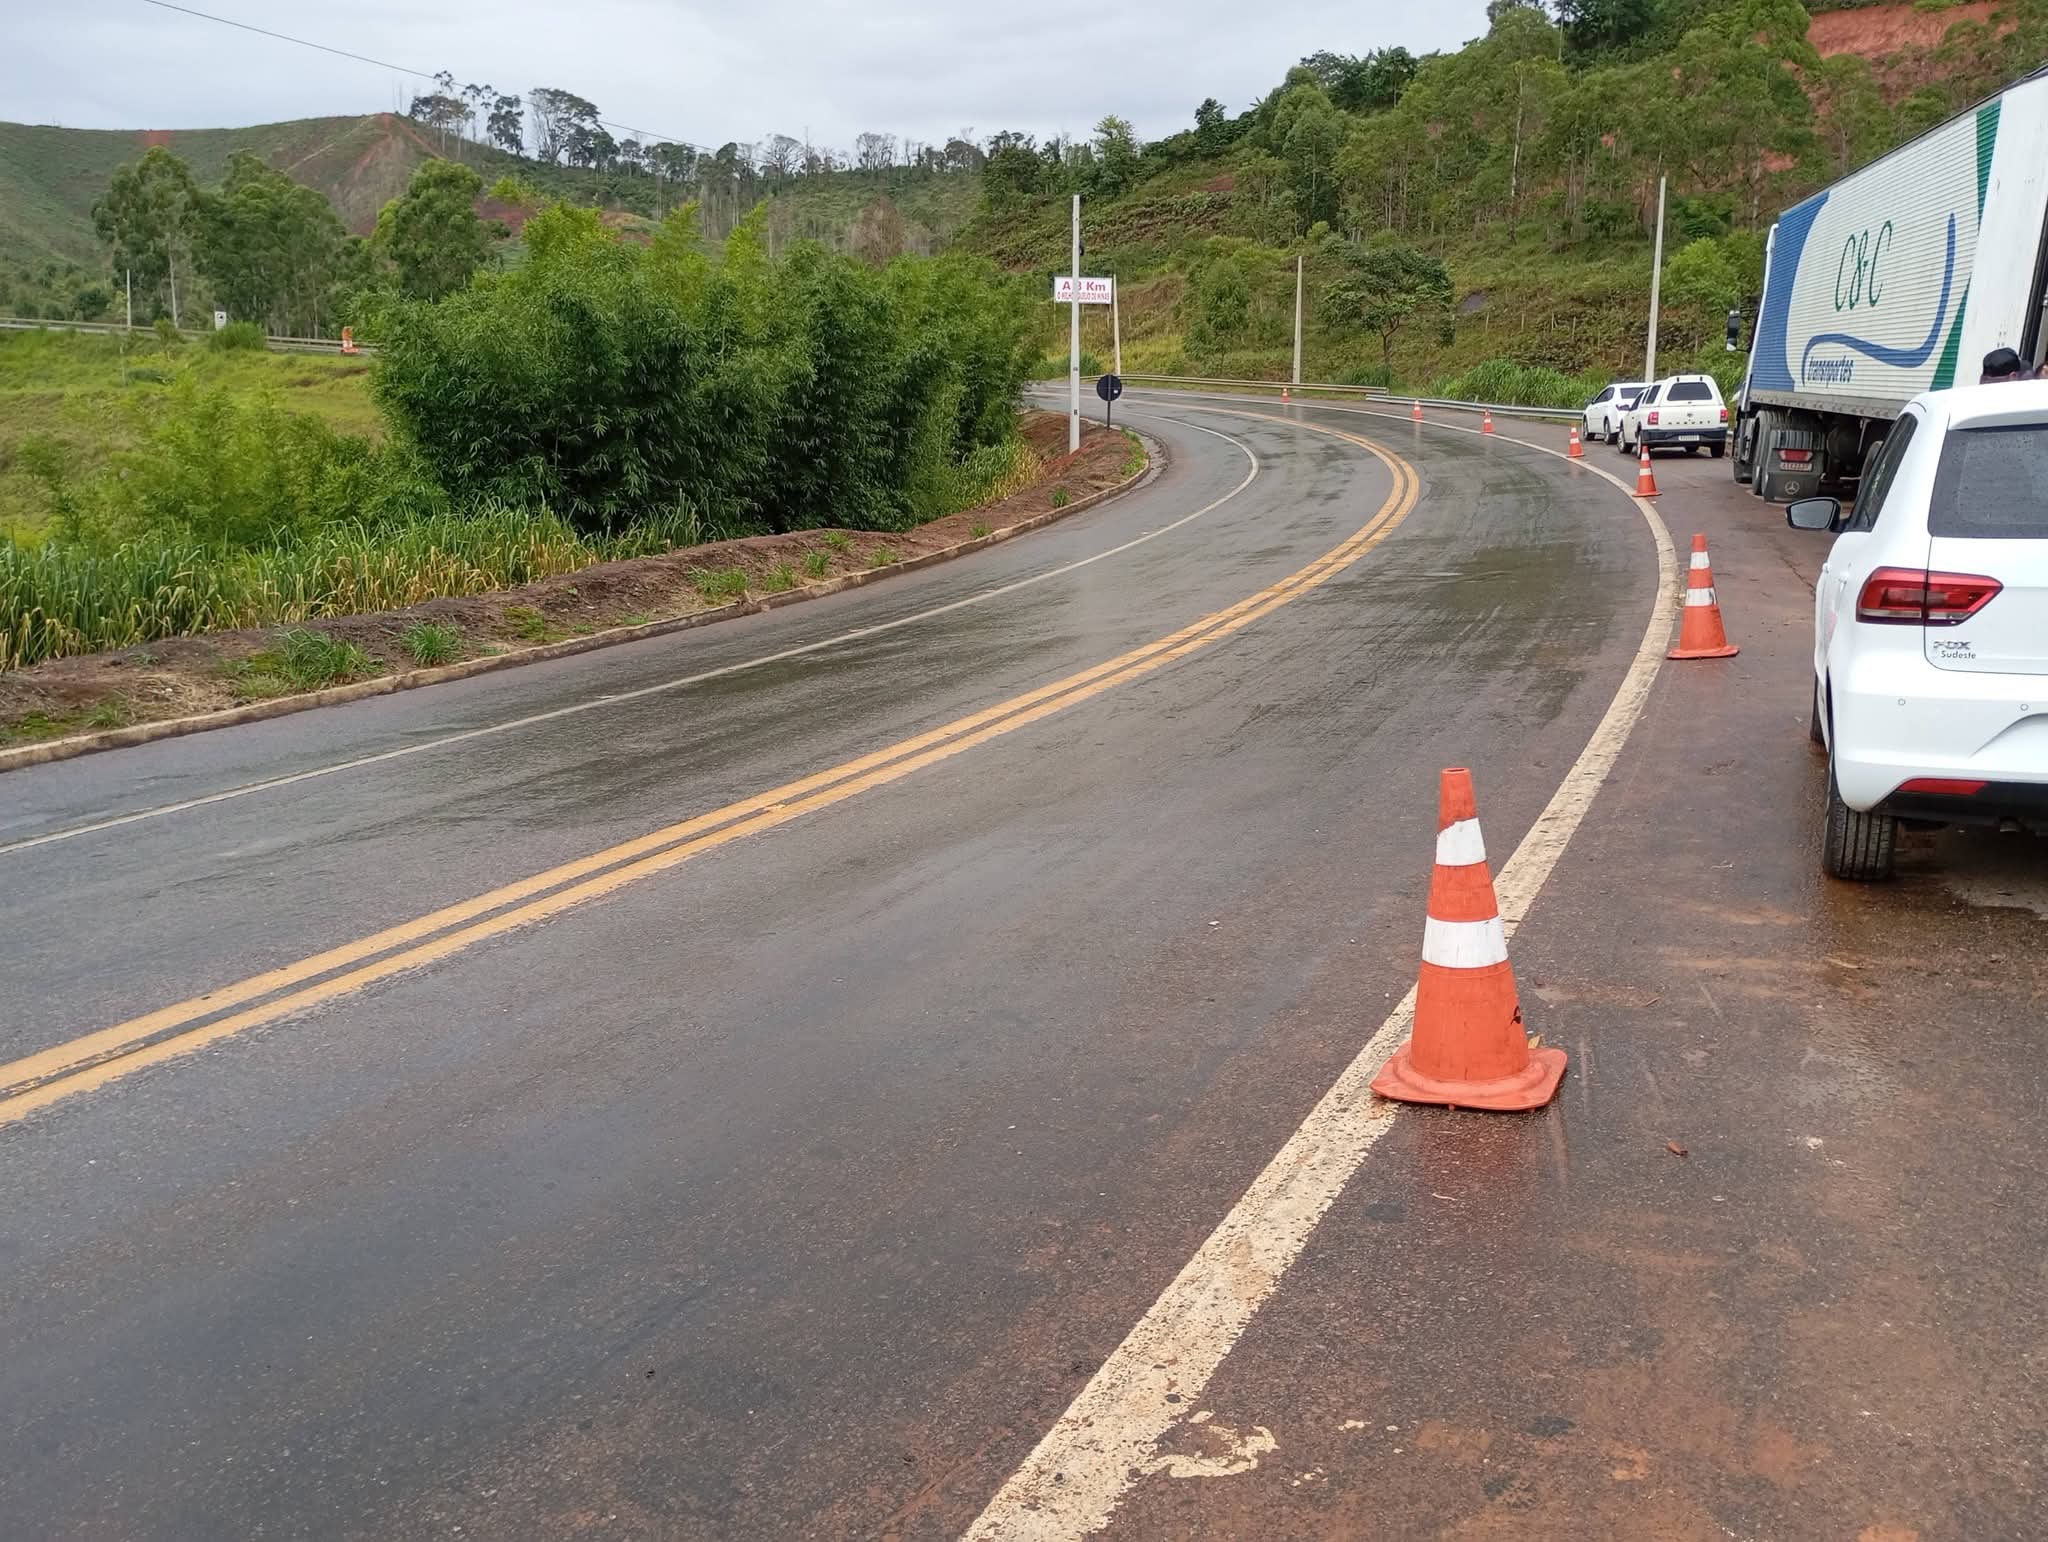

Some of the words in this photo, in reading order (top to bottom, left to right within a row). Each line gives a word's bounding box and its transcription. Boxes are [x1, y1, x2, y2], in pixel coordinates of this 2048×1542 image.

[1835, 220, 1892, 312] C&C
[1063, 281, 1071, 290] A
[1086, 281, 1106, 291] Km
[1940, 650, 1977, 660] Sudeste
